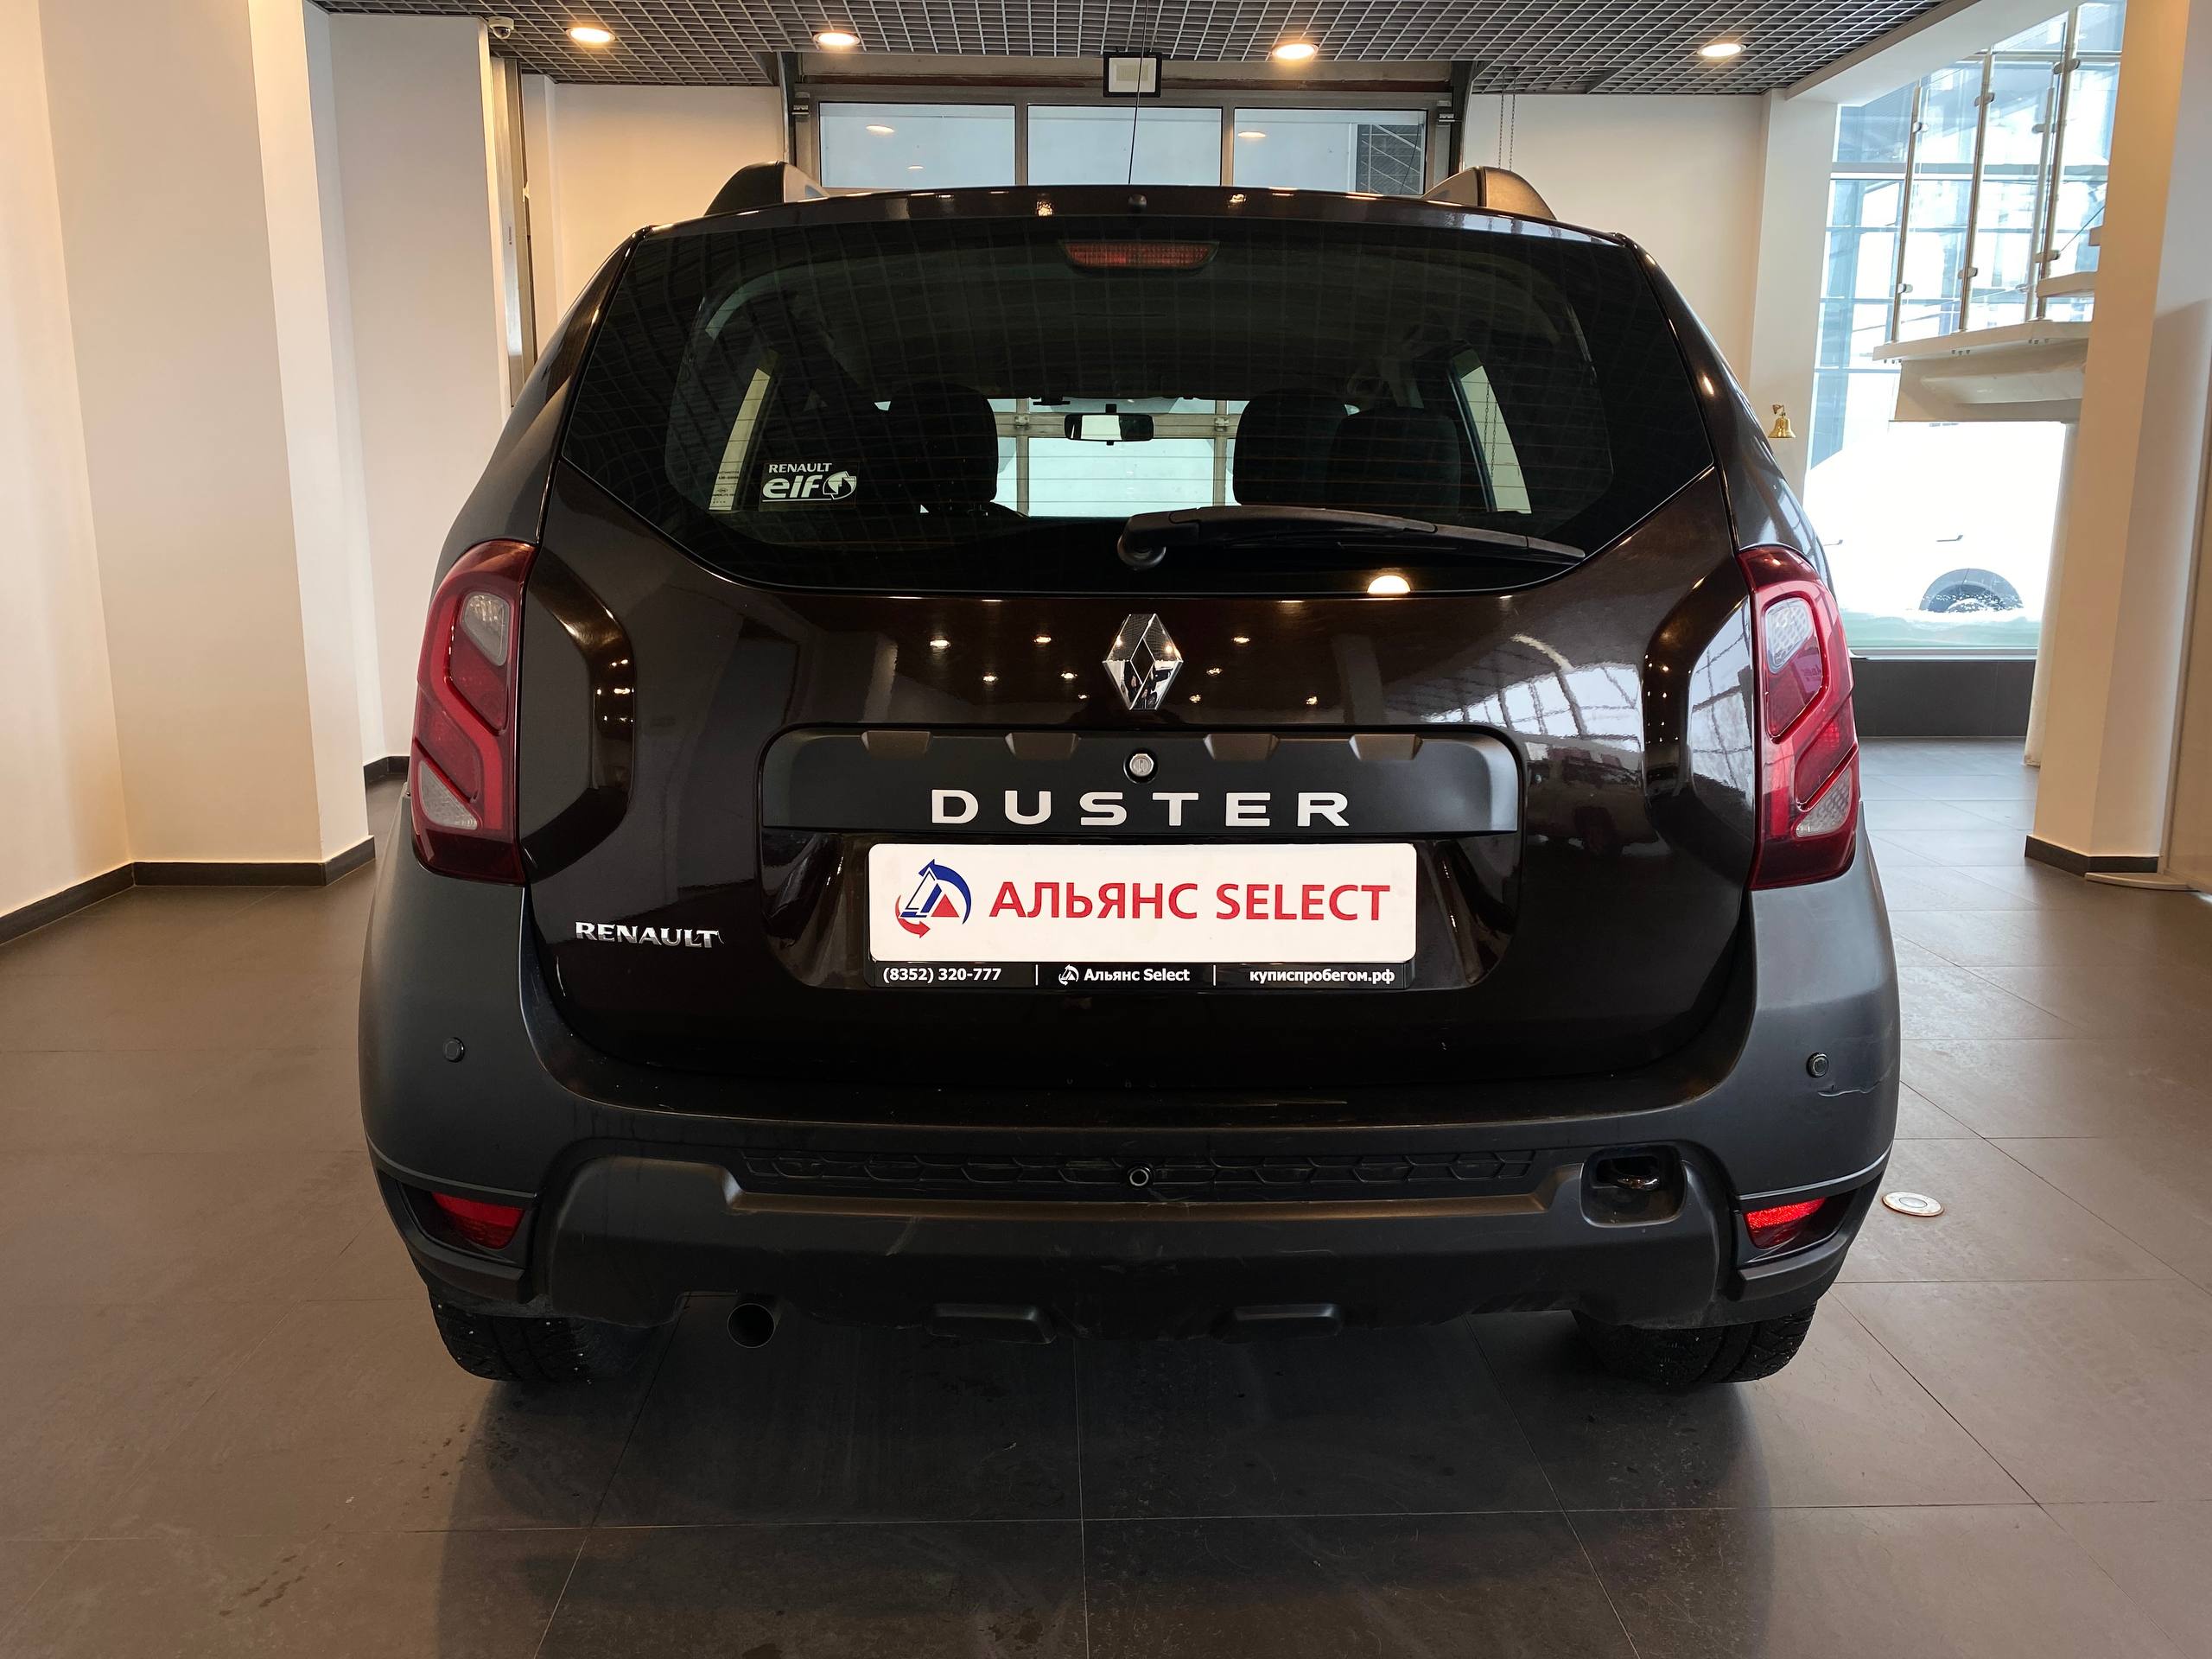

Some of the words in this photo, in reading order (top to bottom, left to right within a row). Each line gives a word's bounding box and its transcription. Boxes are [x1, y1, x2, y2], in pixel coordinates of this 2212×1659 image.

[768, 462, 832, 474] RENAULT
[762, 474, 823, 499] elf
[931, 789, 1350, 827] DUSTER
[989, 881, 1198, 920] АЛЬЯНС
[1216, 882, 1391, 921] SELECT
[575, 921, 724, 949] RENAULT
[882, 967, 934, 983] (8352)
[938, 968, 1001, 981] 320-777
[1084, 968, 1140, 982] Альянс
[1143, 968, 1191, 982] Select
[1249, 968, 1395, 985] куписпробегом.рф
